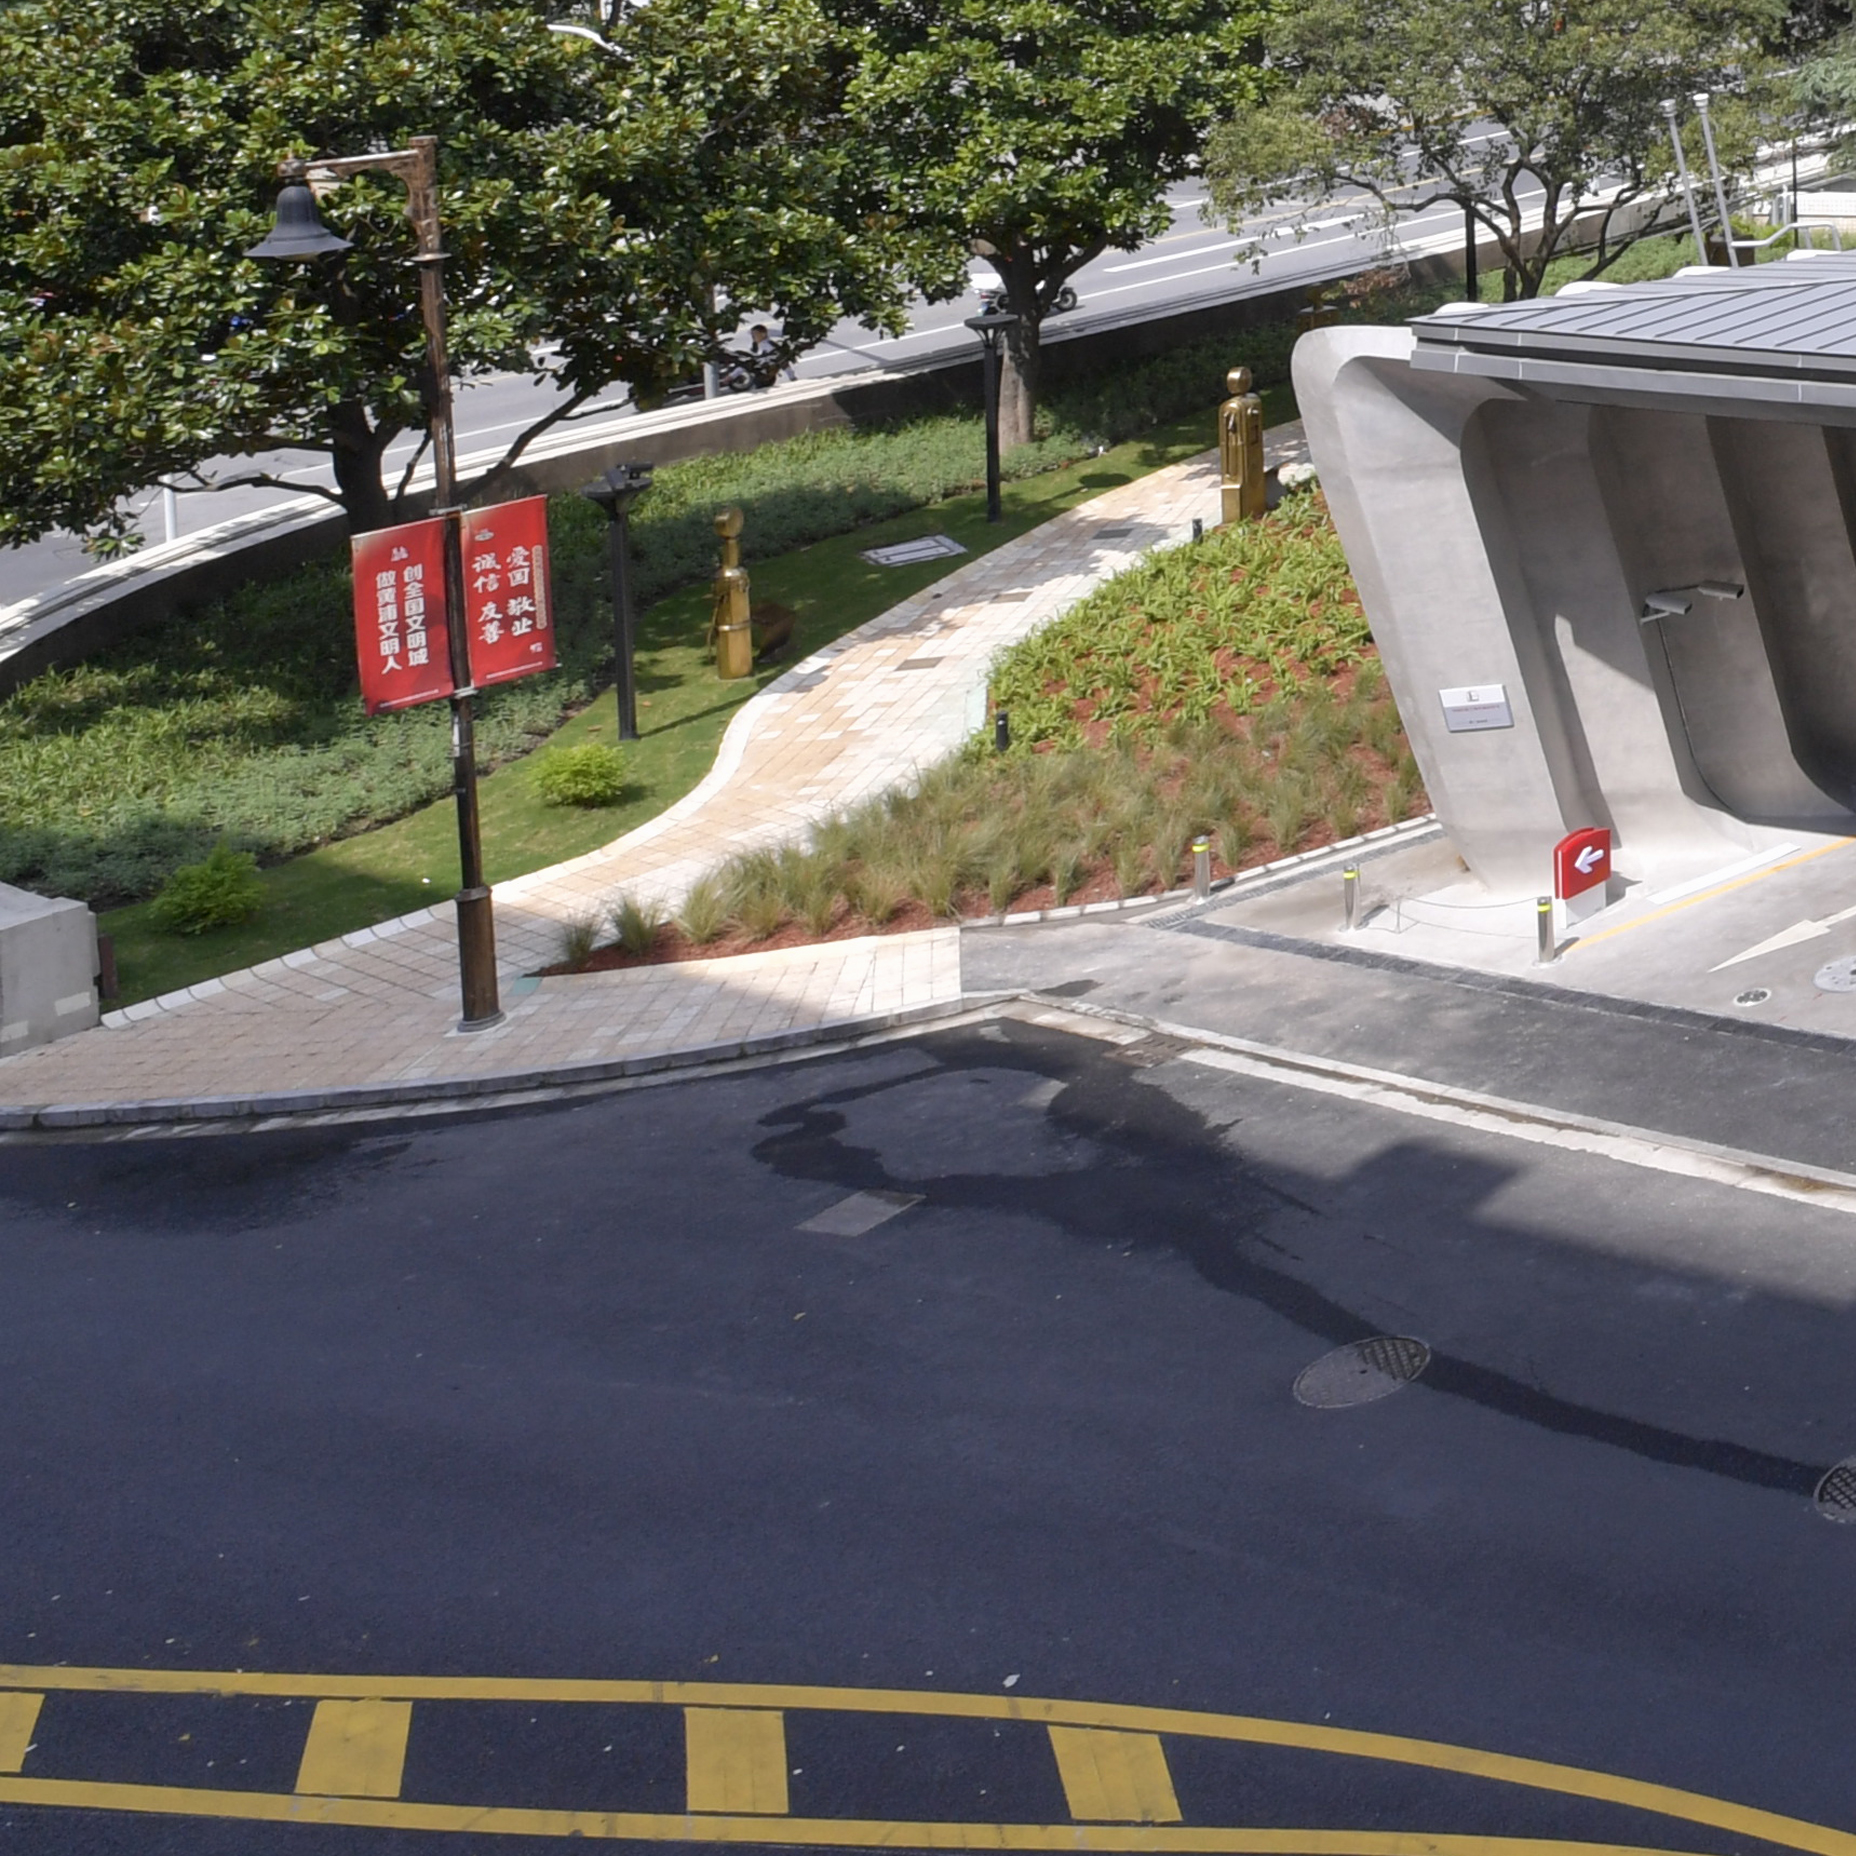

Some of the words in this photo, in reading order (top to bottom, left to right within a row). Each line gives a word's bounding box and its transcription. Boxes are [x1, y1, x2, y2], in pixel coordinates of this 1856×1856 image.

[471, 551, 502, 594] 诚信
[506, 545, 531, 588] 爱国
[477, 600, 505, 645] 友善
[506, 595, 536, 637] 敬业
